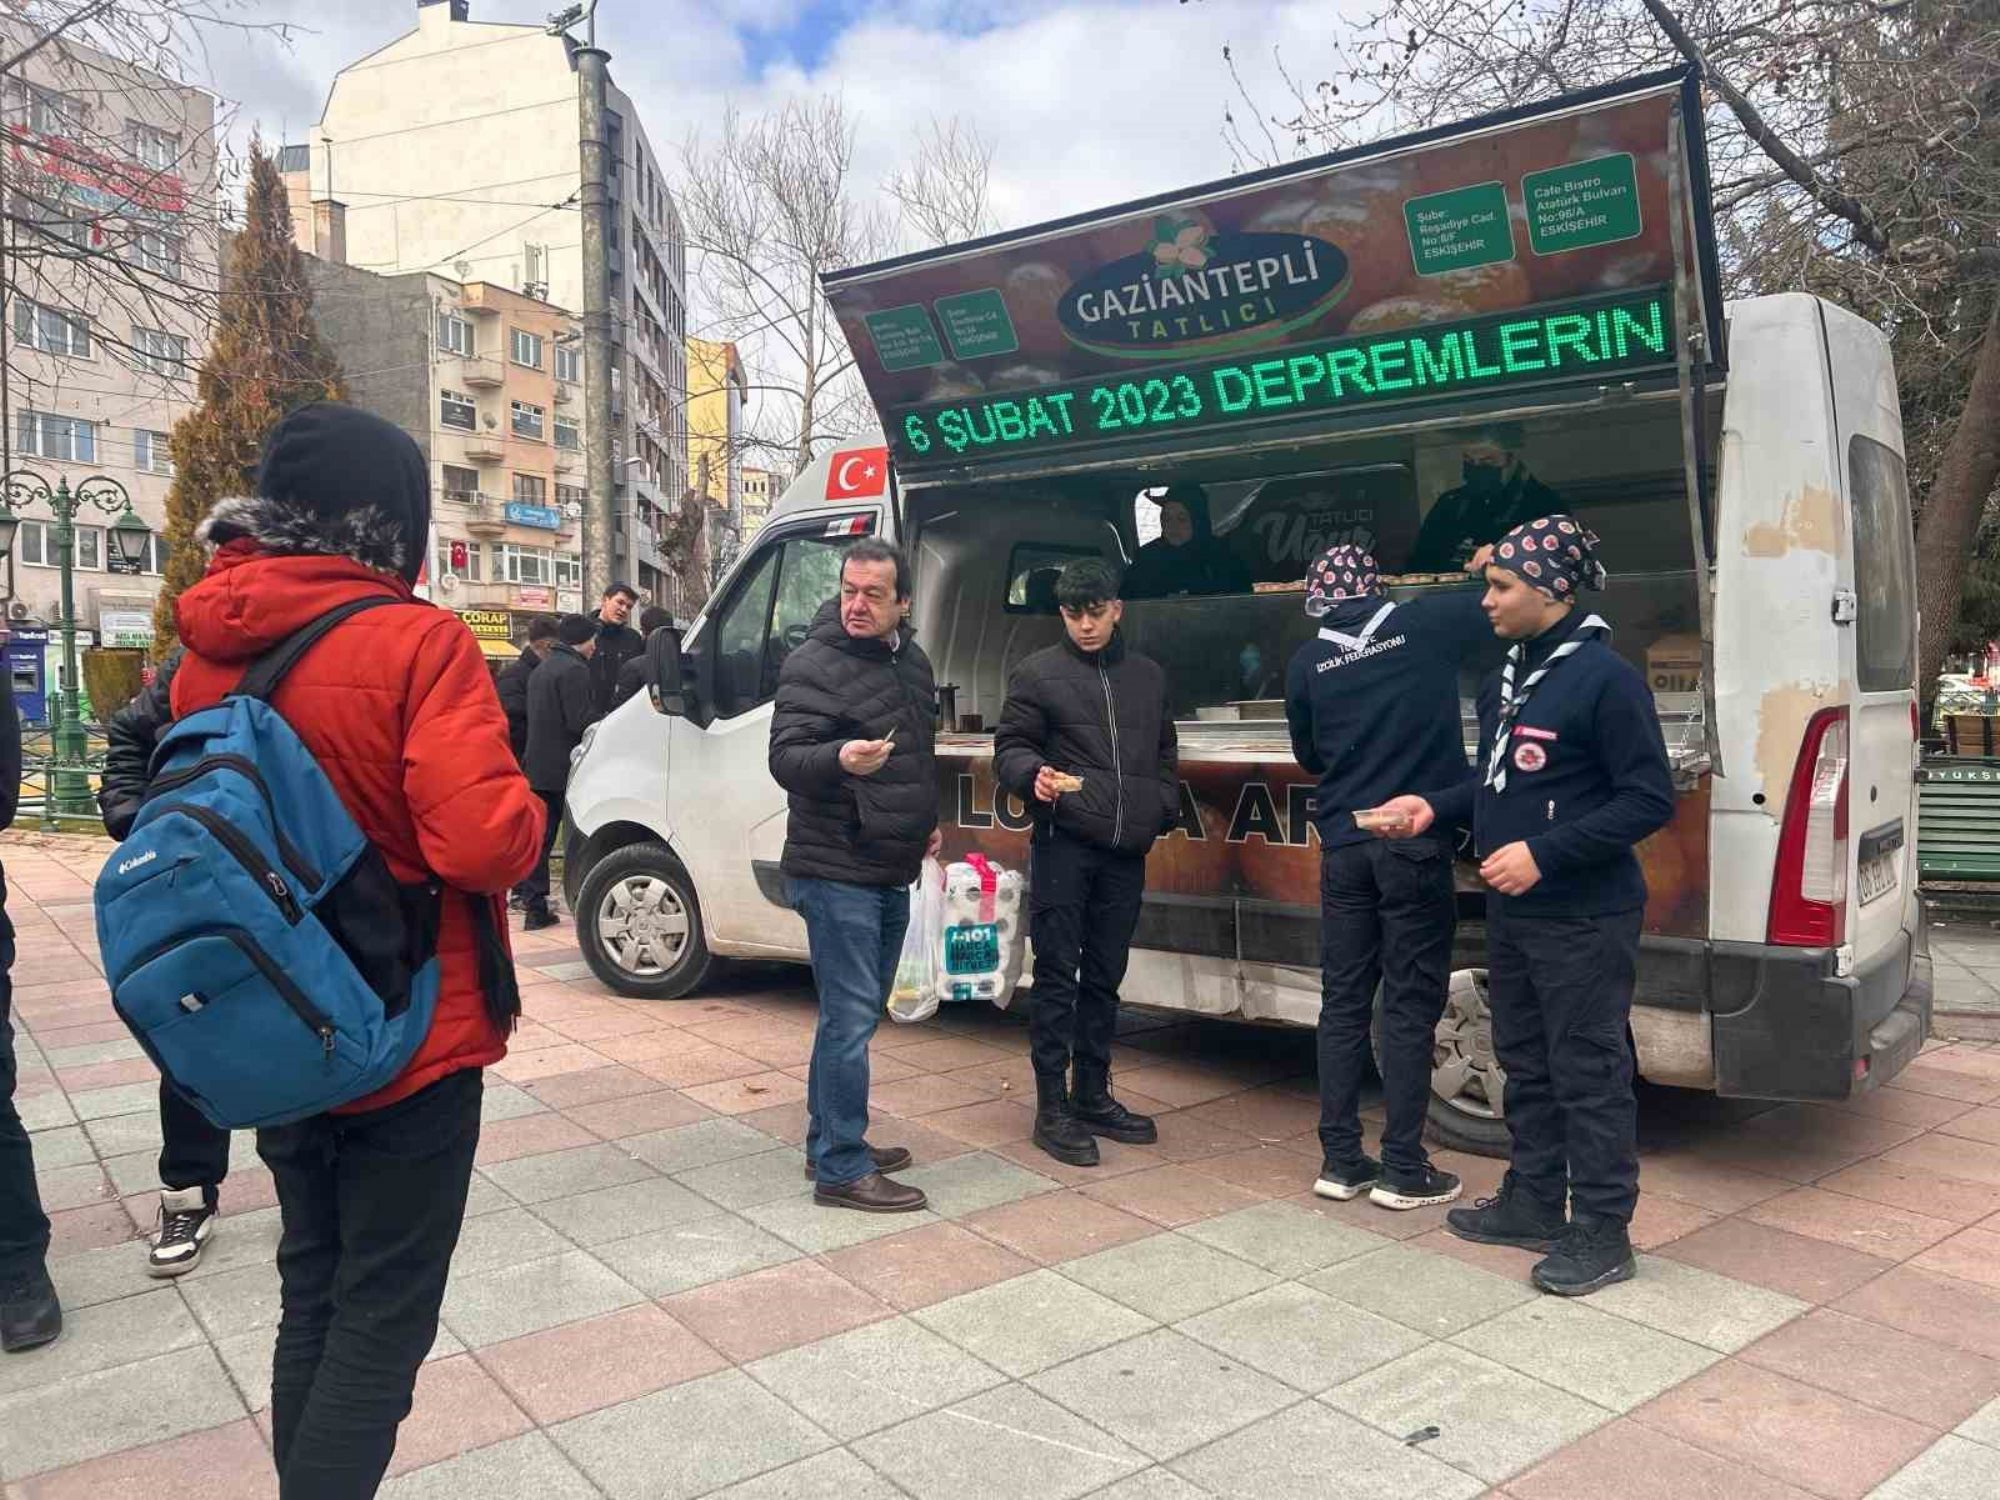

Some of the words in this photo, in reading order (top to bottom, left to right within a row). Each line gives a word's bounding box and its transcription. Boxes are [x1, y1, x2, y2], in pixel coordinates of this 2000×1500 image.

[1563, 177, 1601, 192] Bistro
[1076, 240, 1320, 323] GAZİANTEPLİ
[1128, 297, 1276, 339] TATLICI
[905, 414, 931, 452] 6
[936, 392, 1074, 452] ŞUBAT
[1090, 374, 1202, 430] 2023
[1212, 301, 1667, 413] DEPREMLERIN
